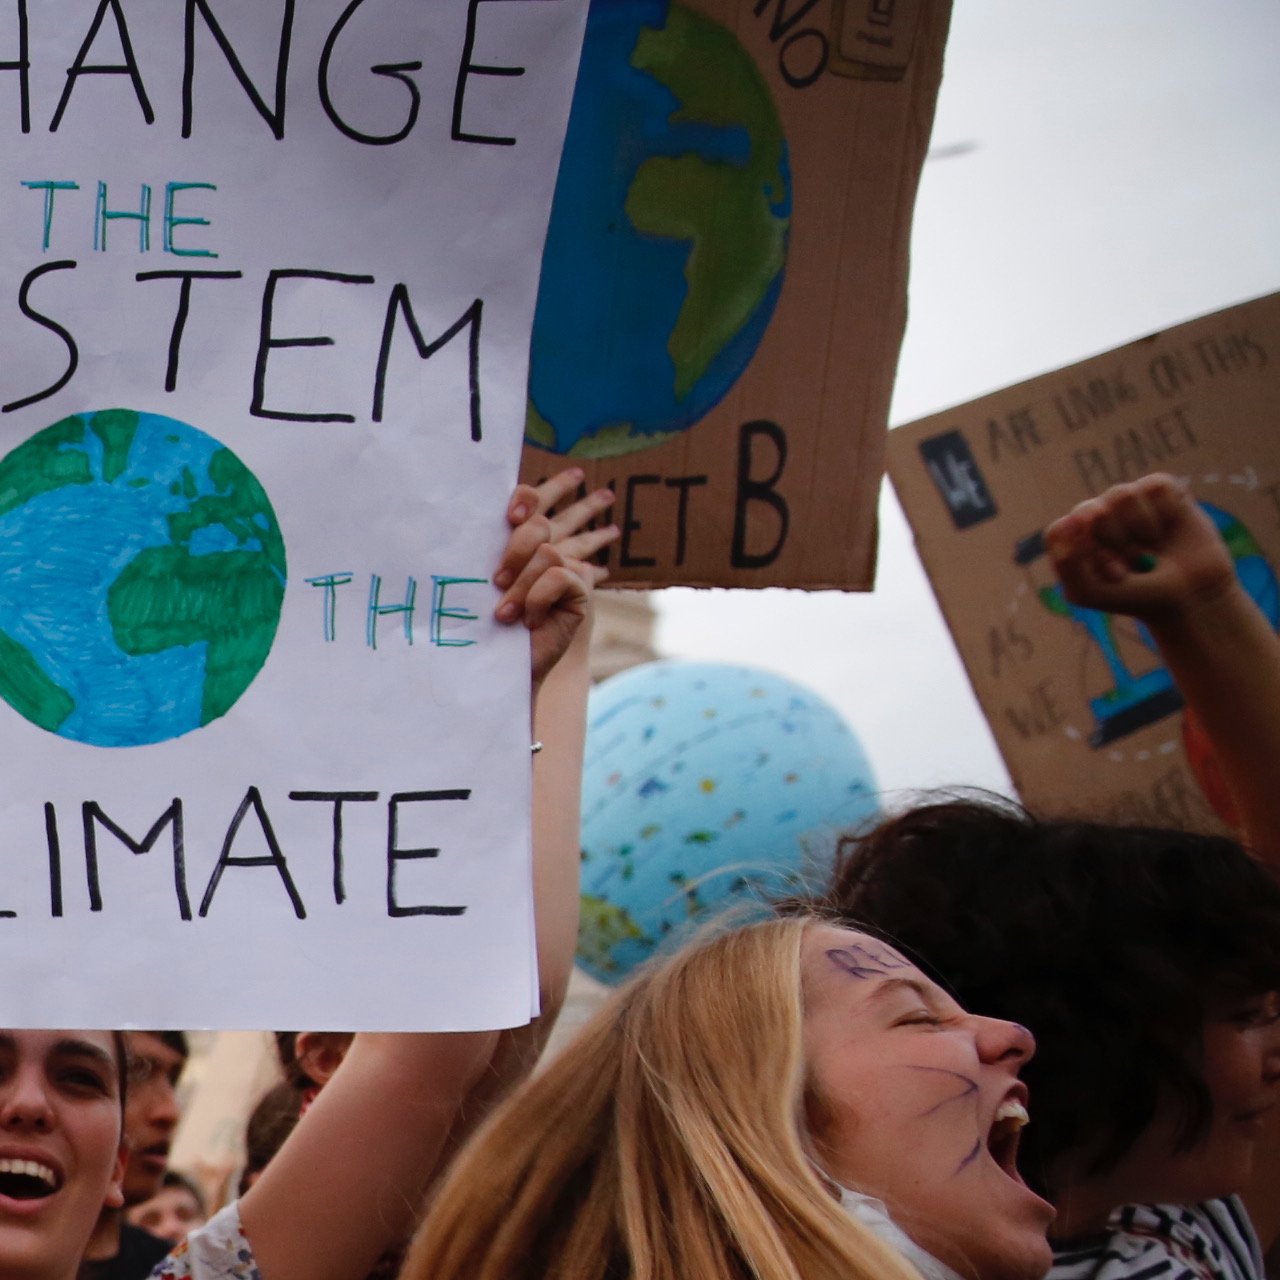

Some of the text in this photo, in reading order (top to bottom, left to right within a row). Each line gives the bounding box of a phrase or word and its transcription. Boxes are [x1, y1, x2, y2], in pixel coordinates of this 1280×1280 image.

[20, 180, 219, 259] THE
[730, 419, 790, 570] B
[305, 571, 491, 651] THE
